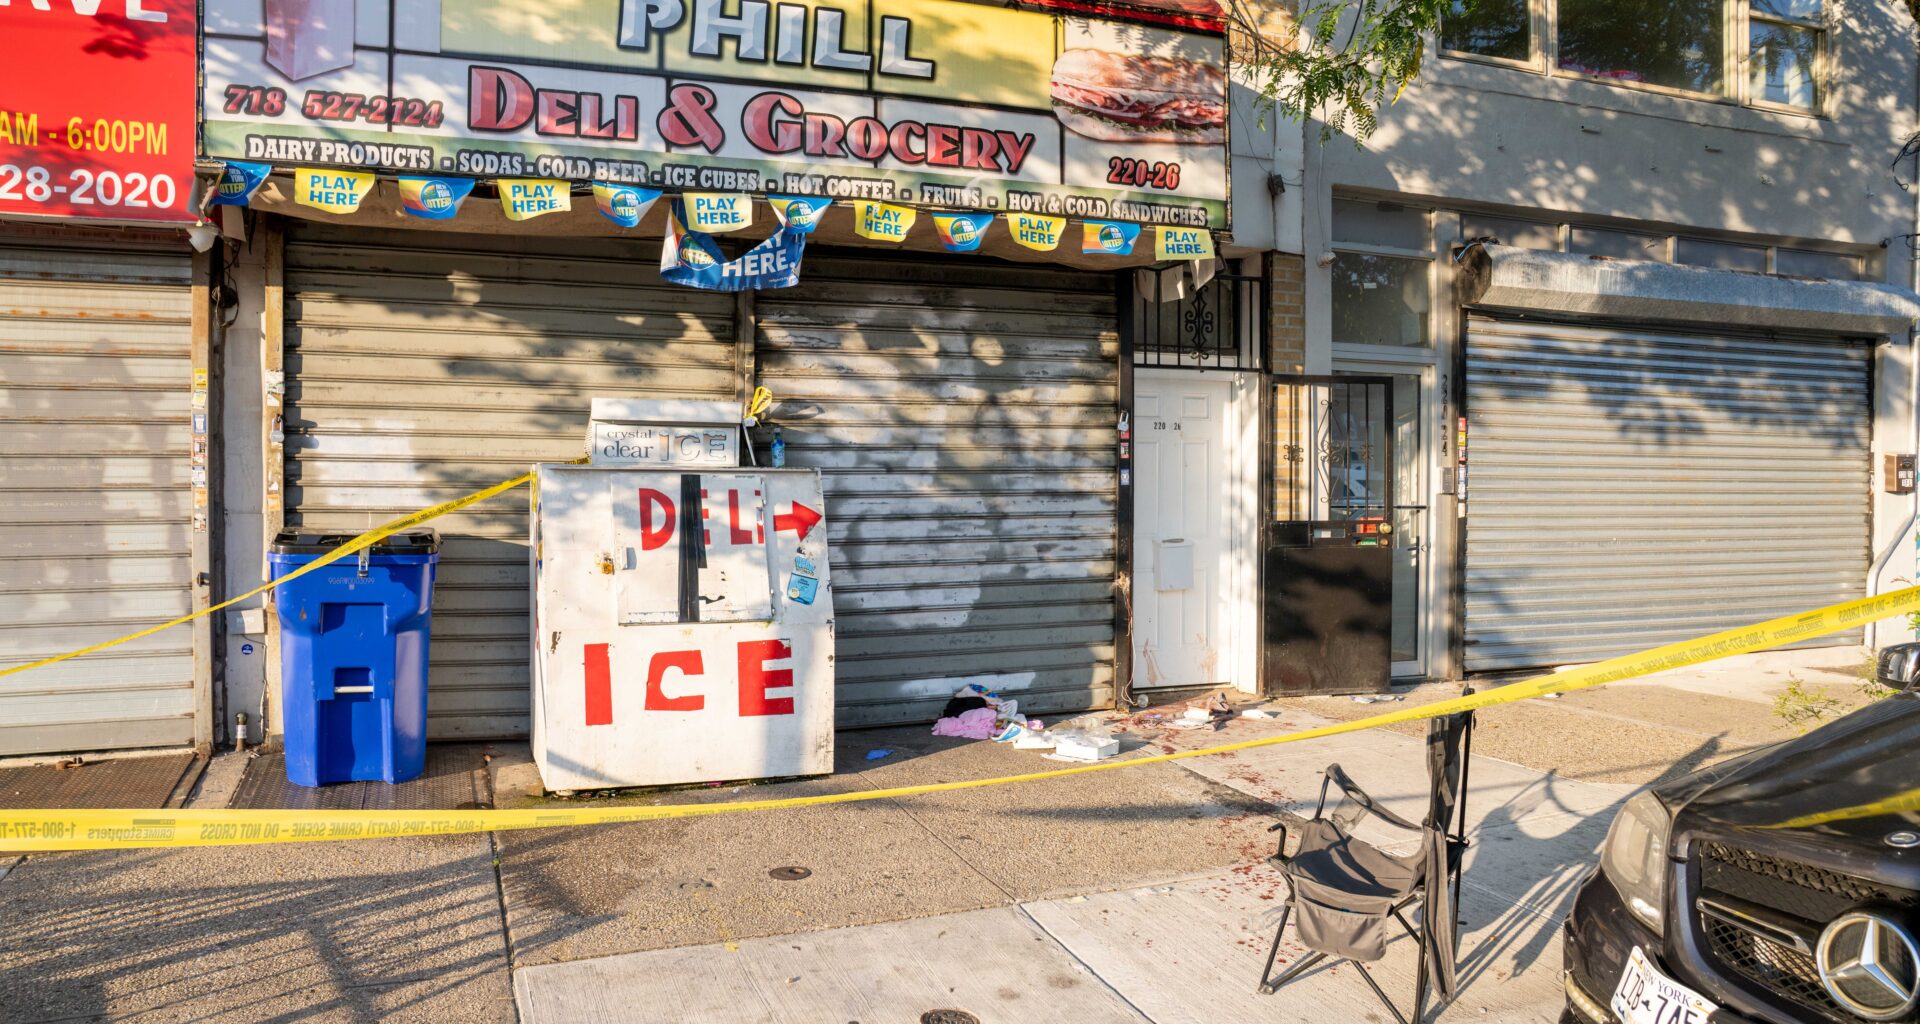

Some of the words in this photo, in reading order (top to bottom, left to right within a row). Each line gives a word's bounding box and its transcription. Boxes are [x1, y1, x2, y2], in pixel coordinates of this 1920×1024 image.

[617, 0, 935, 80] PHILL
[225, 84, 287, 116] 718
[302, 90, 444, 128] 527-2124
[468, 65, 638, 142] DELI
[656, 83, 725, 153] &
[741, 91, 1036, 174] GROCERY
[67, 117, 168, 156] 6:00PM
[248, 136, 314, 162] DAIRY
[320, 141, 431, 169] PRODUCTS
[459, 152, 523, 176] SODAS
[538, 157, 591, 179] COLD
[594, 162, 647, 183] BEER
[664, 167, 695, 187] ICE
[700, 168, 759, 191] CUBES
[786, 175, 823, 195] HOT
[827, 178, 893, 200] COFFEE
[923, 185, 980, 207] FRUITS
[1008, 192, 1042, 212] HOT
[1047, 196, 1062, 214] &
[1065, 198, 1107, 218] COLD
[1112, 202, 1207, 226] SANDWICHES
[310, 174, 357, 191] PLAY
[1107, 156, 1181, 190] 220-26
[0, 164, 176, 209] 28-2020
[511, 184, 556, 198] PLAY
[512, 198, 563, 213] HERE.
[695, 197, 737, 211] PLAY
[865, 204, 902, 223] PLAY
[696, 211, 745, 225] HERE.
[1019, 217, 1054, 232] PLAY
[1165, 230, 1198, 244] PLAY
[1165, 243, 1207, 255] HERE.
[722, 249, 796, 277] HERE.
[606, 428, 654, 441] crystal
[1153, 421, 1166, 430] 220
[603, 440, 655, 459] clear
[658, 430, 727, 462] ICE
[583, 637, 795, 727] ICE
[1657, 980, 1693, 1008] YORK
